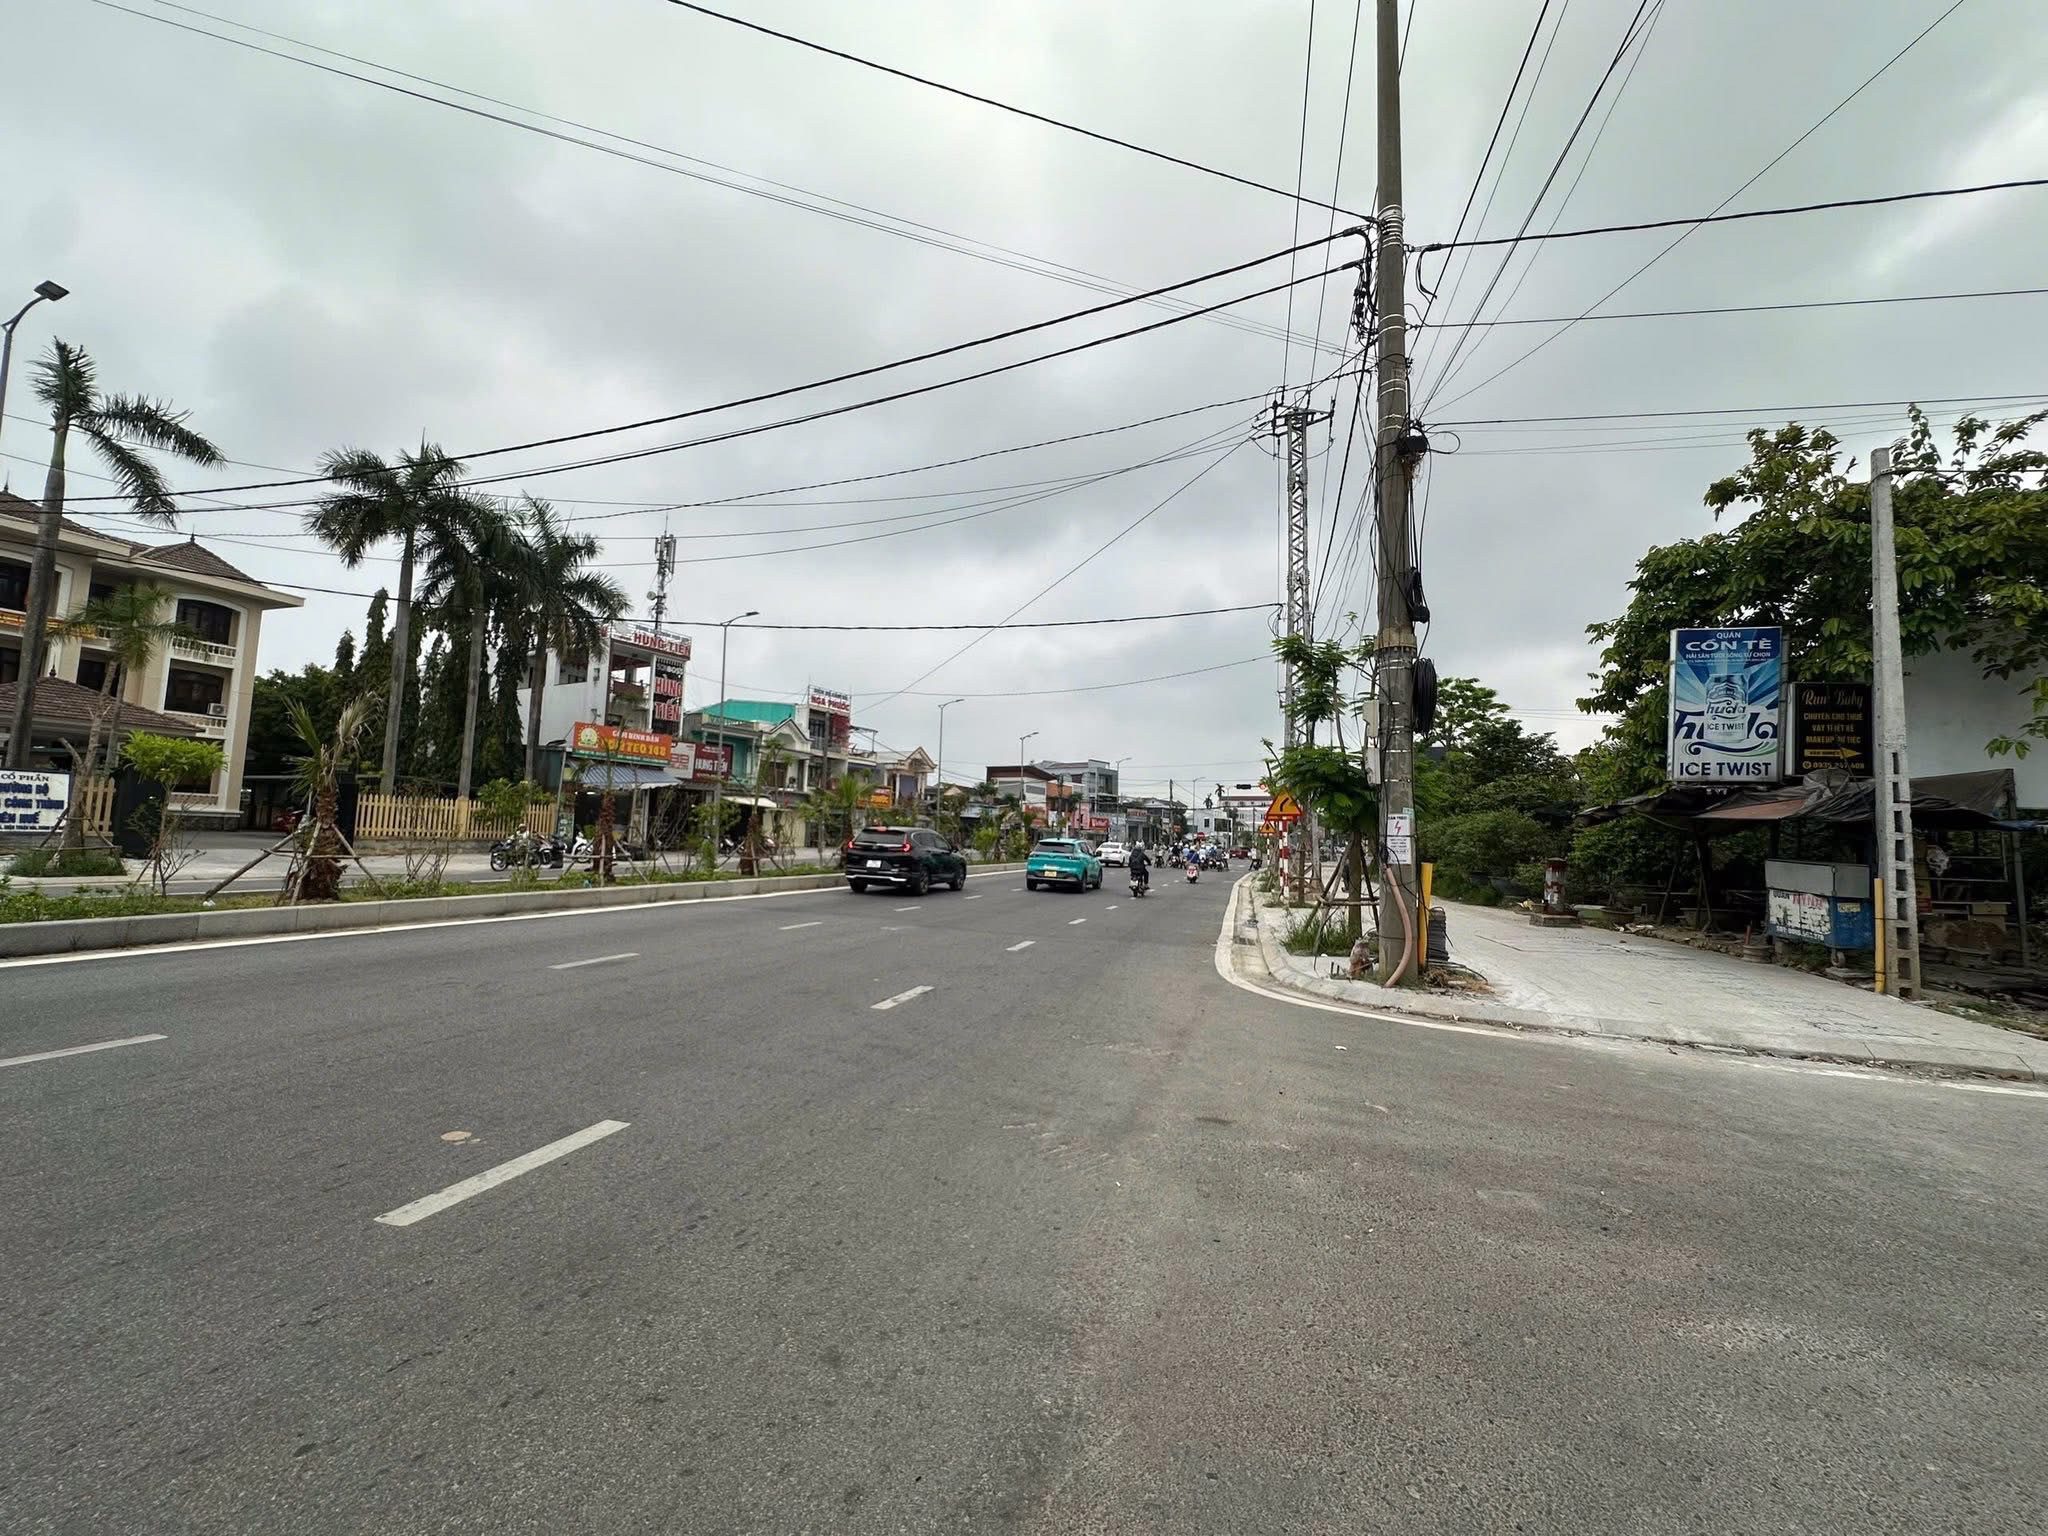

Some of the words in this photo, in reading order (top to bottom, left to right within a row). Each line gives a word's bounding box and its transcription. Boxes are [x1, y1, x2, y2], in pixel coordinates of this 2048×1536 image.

[1716, 631, 1742, 640] QUÁN
[1680, 762, 1711, 776] ICE
[1716, 762, 1772, 776] TWIST
